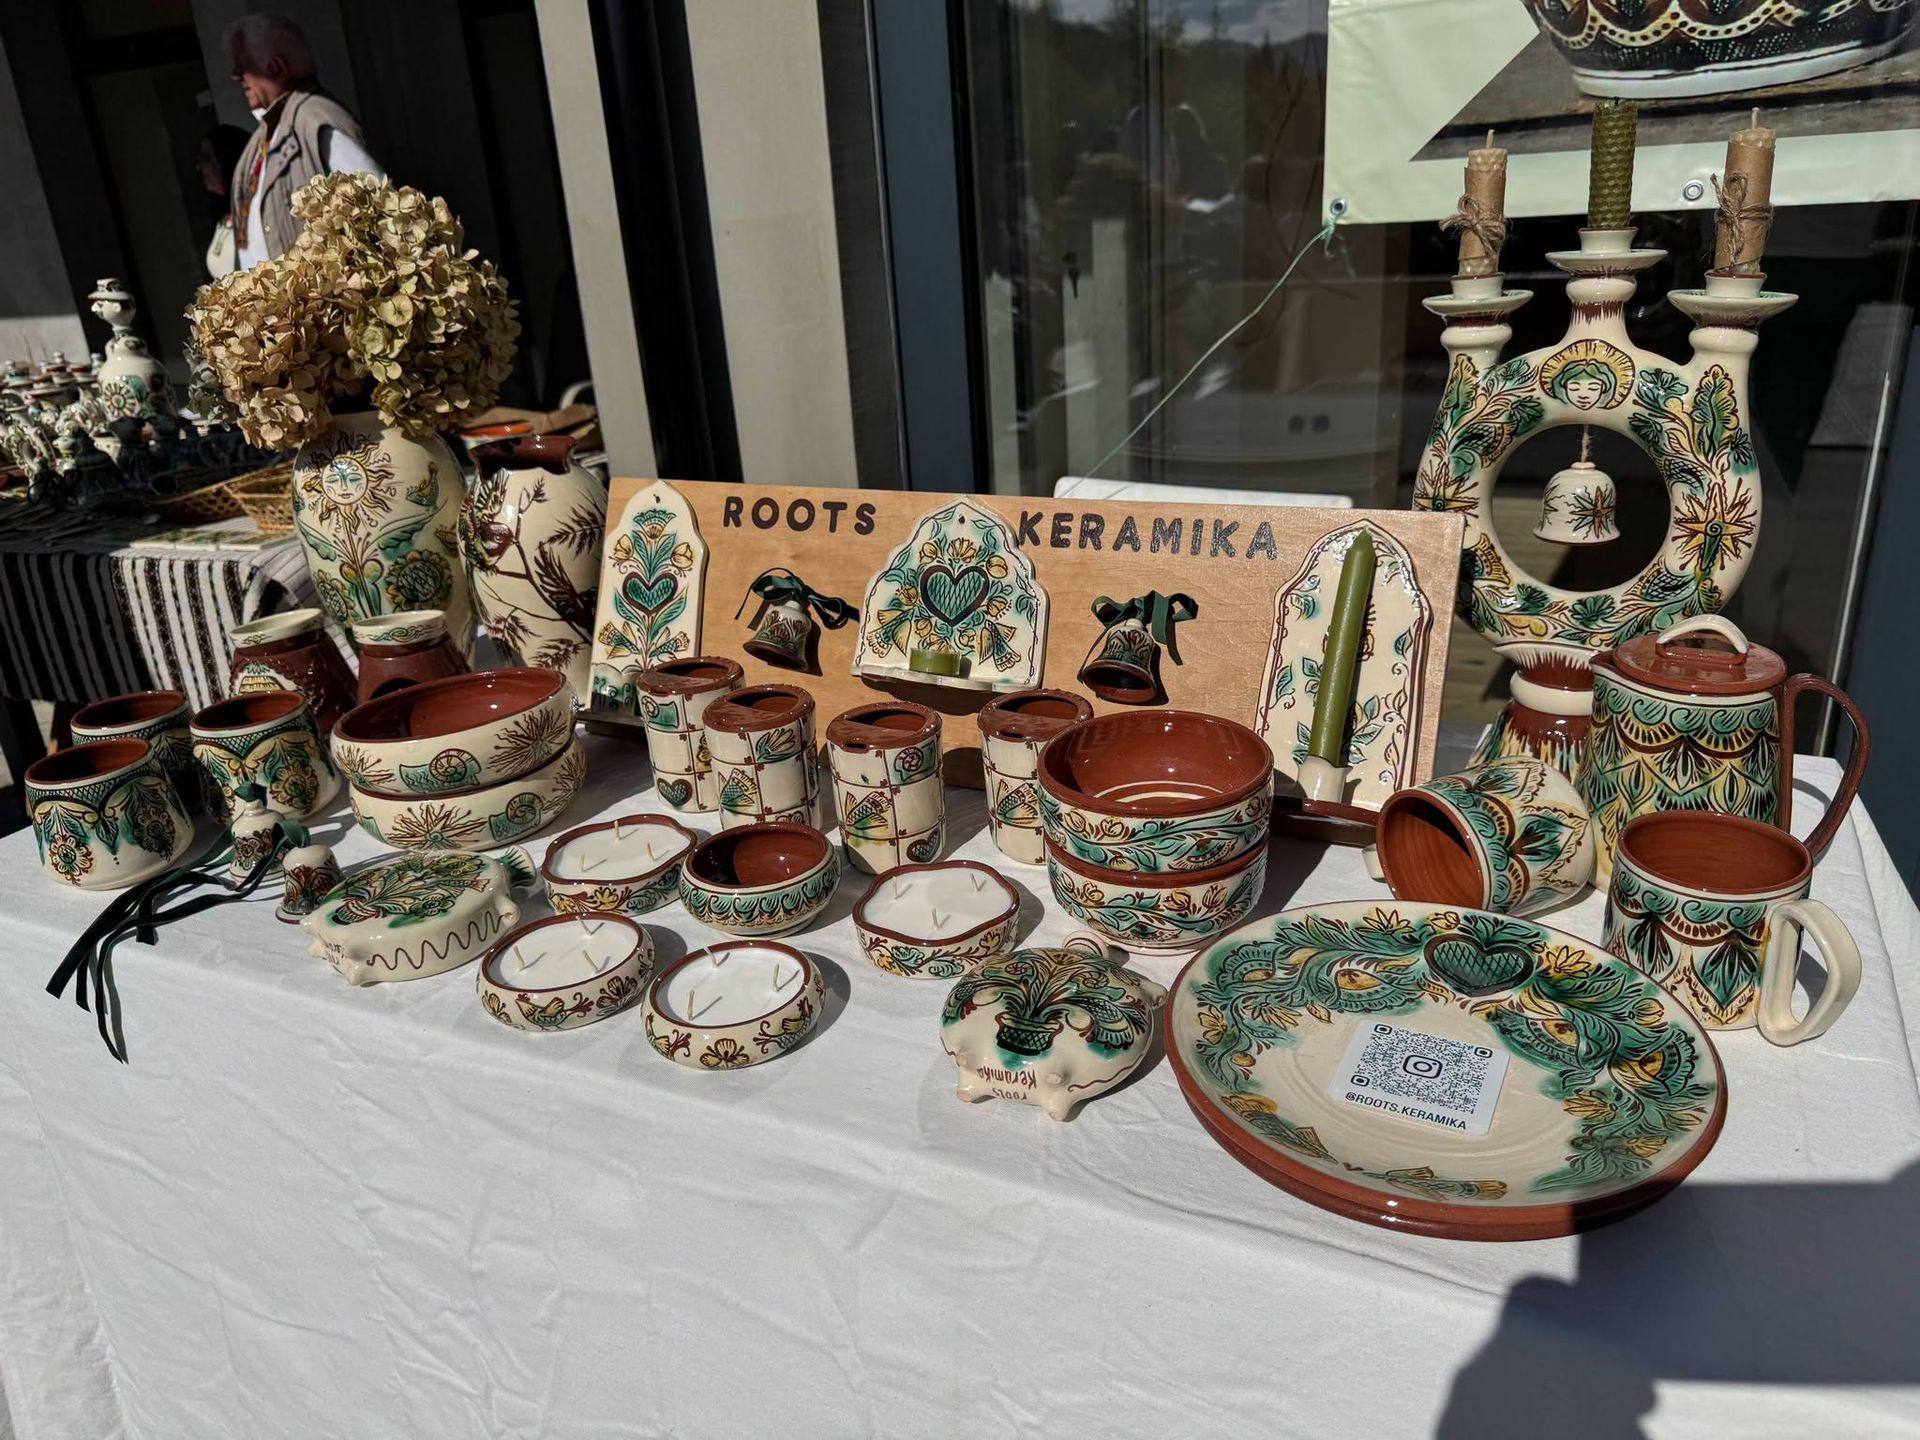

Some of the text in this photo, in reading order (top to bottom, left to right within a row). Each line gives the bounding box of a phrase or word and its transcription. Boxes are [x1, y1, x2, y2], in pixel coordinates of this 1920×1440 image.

[723, 496, 1278, 559] ROOTS KERAMIKA
[1345, 1091, 1467, 1130] @ROOTS.KERAMIKA
